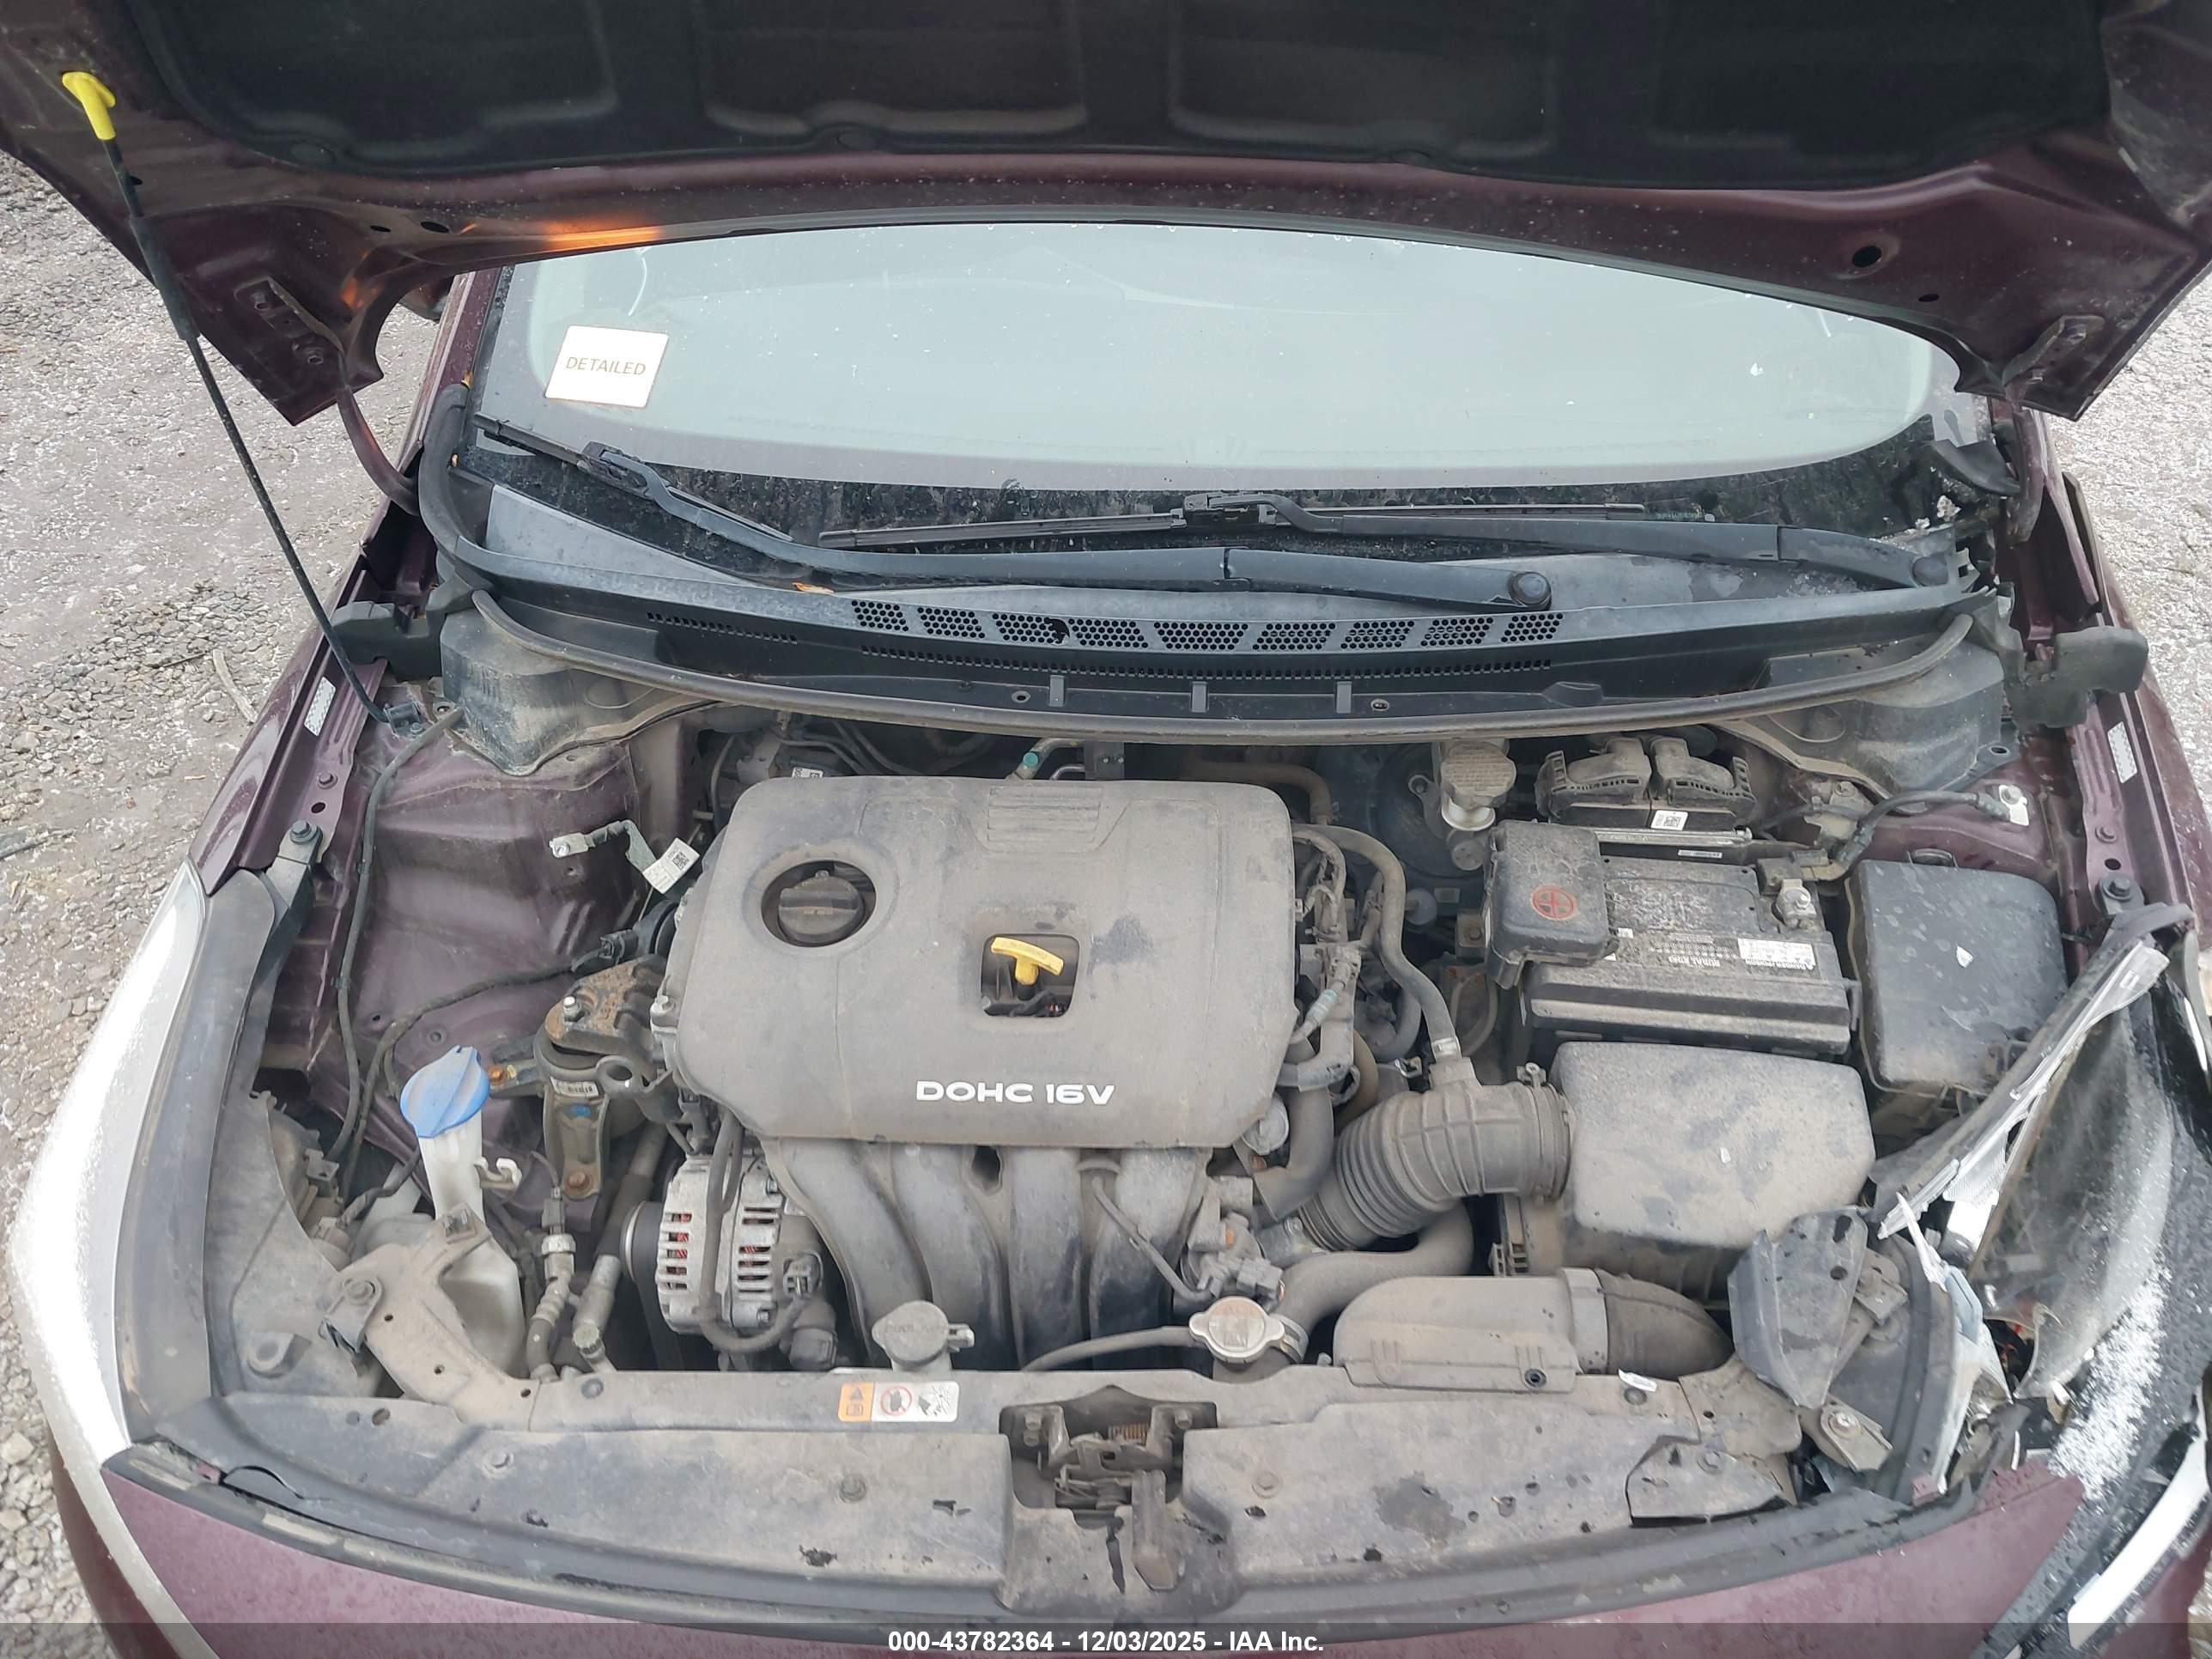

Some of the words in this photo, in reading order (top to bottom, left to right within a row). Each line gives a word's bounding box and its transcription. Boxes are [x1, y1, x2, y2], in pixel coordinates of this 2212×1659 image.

[564, 356, 647, 375] DETAILED
[915, 1080, 1034, 1103] DOHC
[1045, 1083, 1115, 1105] 16V
